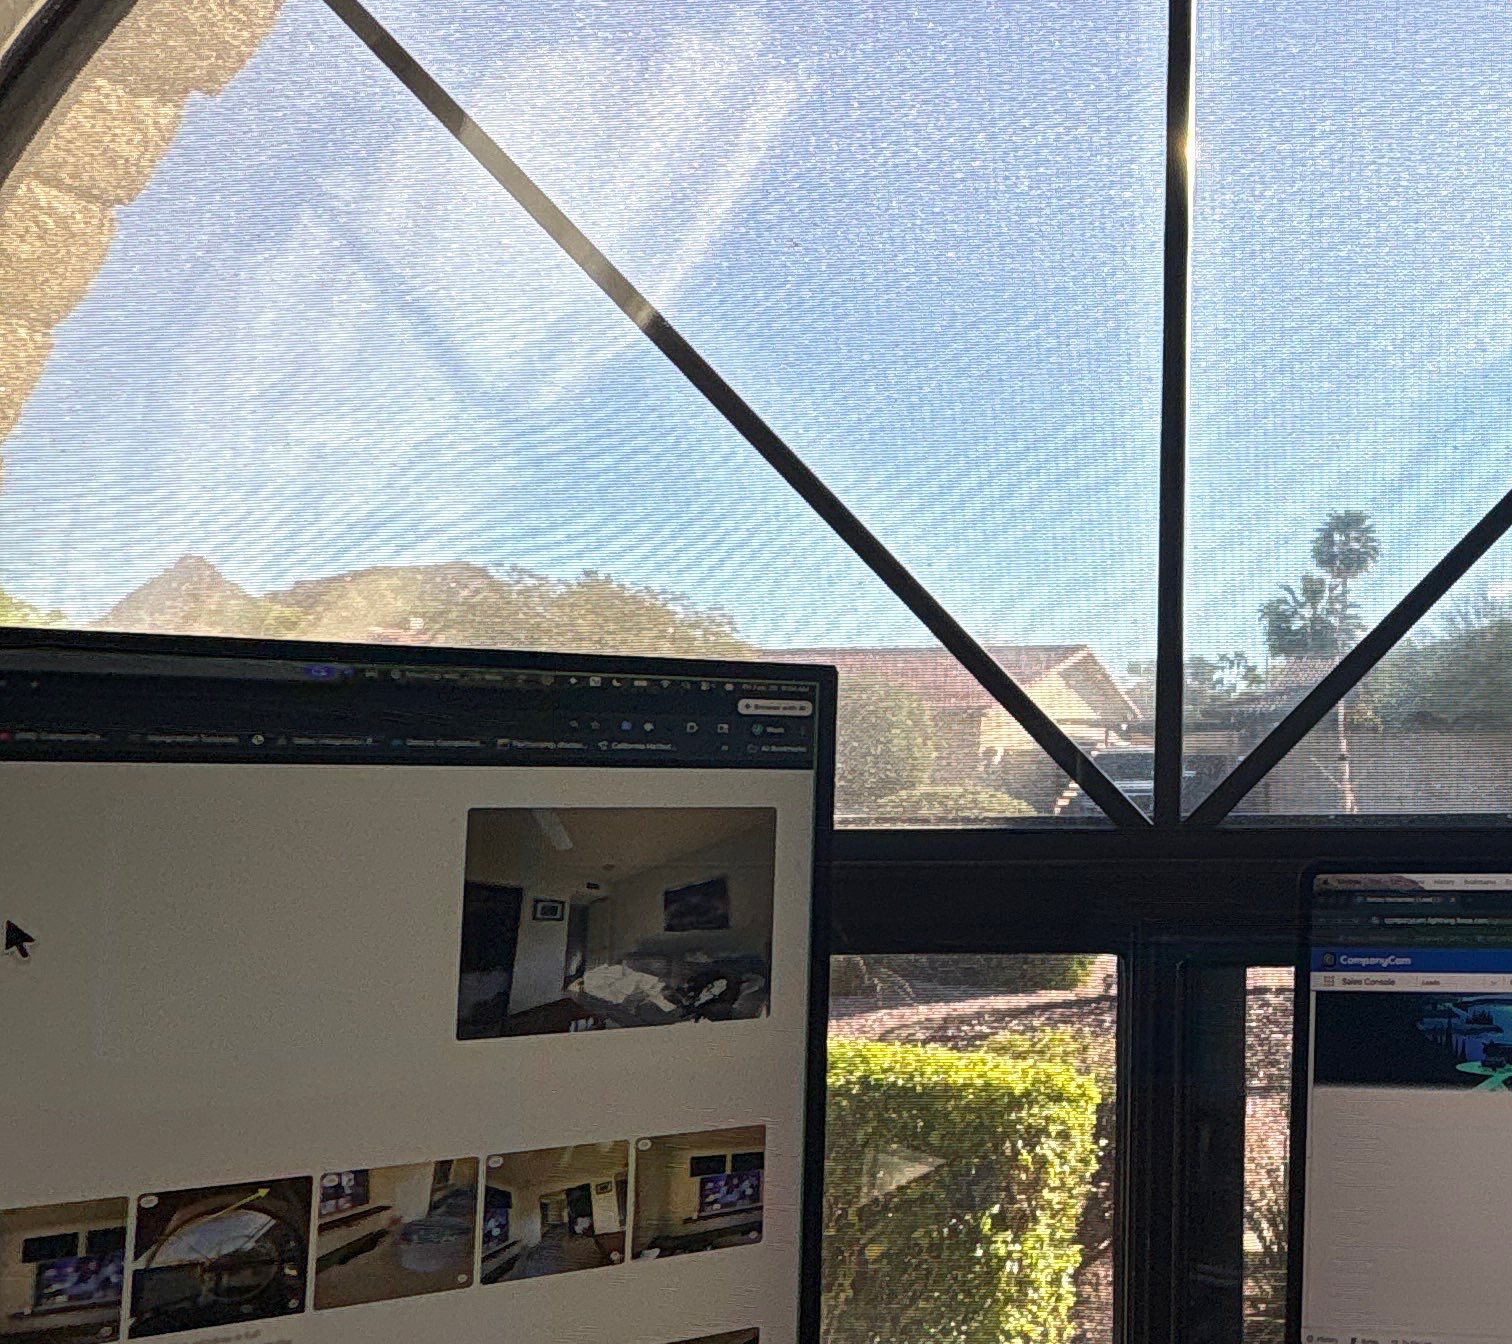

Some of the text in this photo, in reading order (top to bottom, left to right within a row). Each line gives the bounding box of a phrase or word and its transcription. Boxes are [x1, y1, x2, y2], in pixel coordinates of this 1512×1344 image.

[1339, 955, 1412, 967] CompanyCam
[1341, 976, 1396, 986] Sales Console
